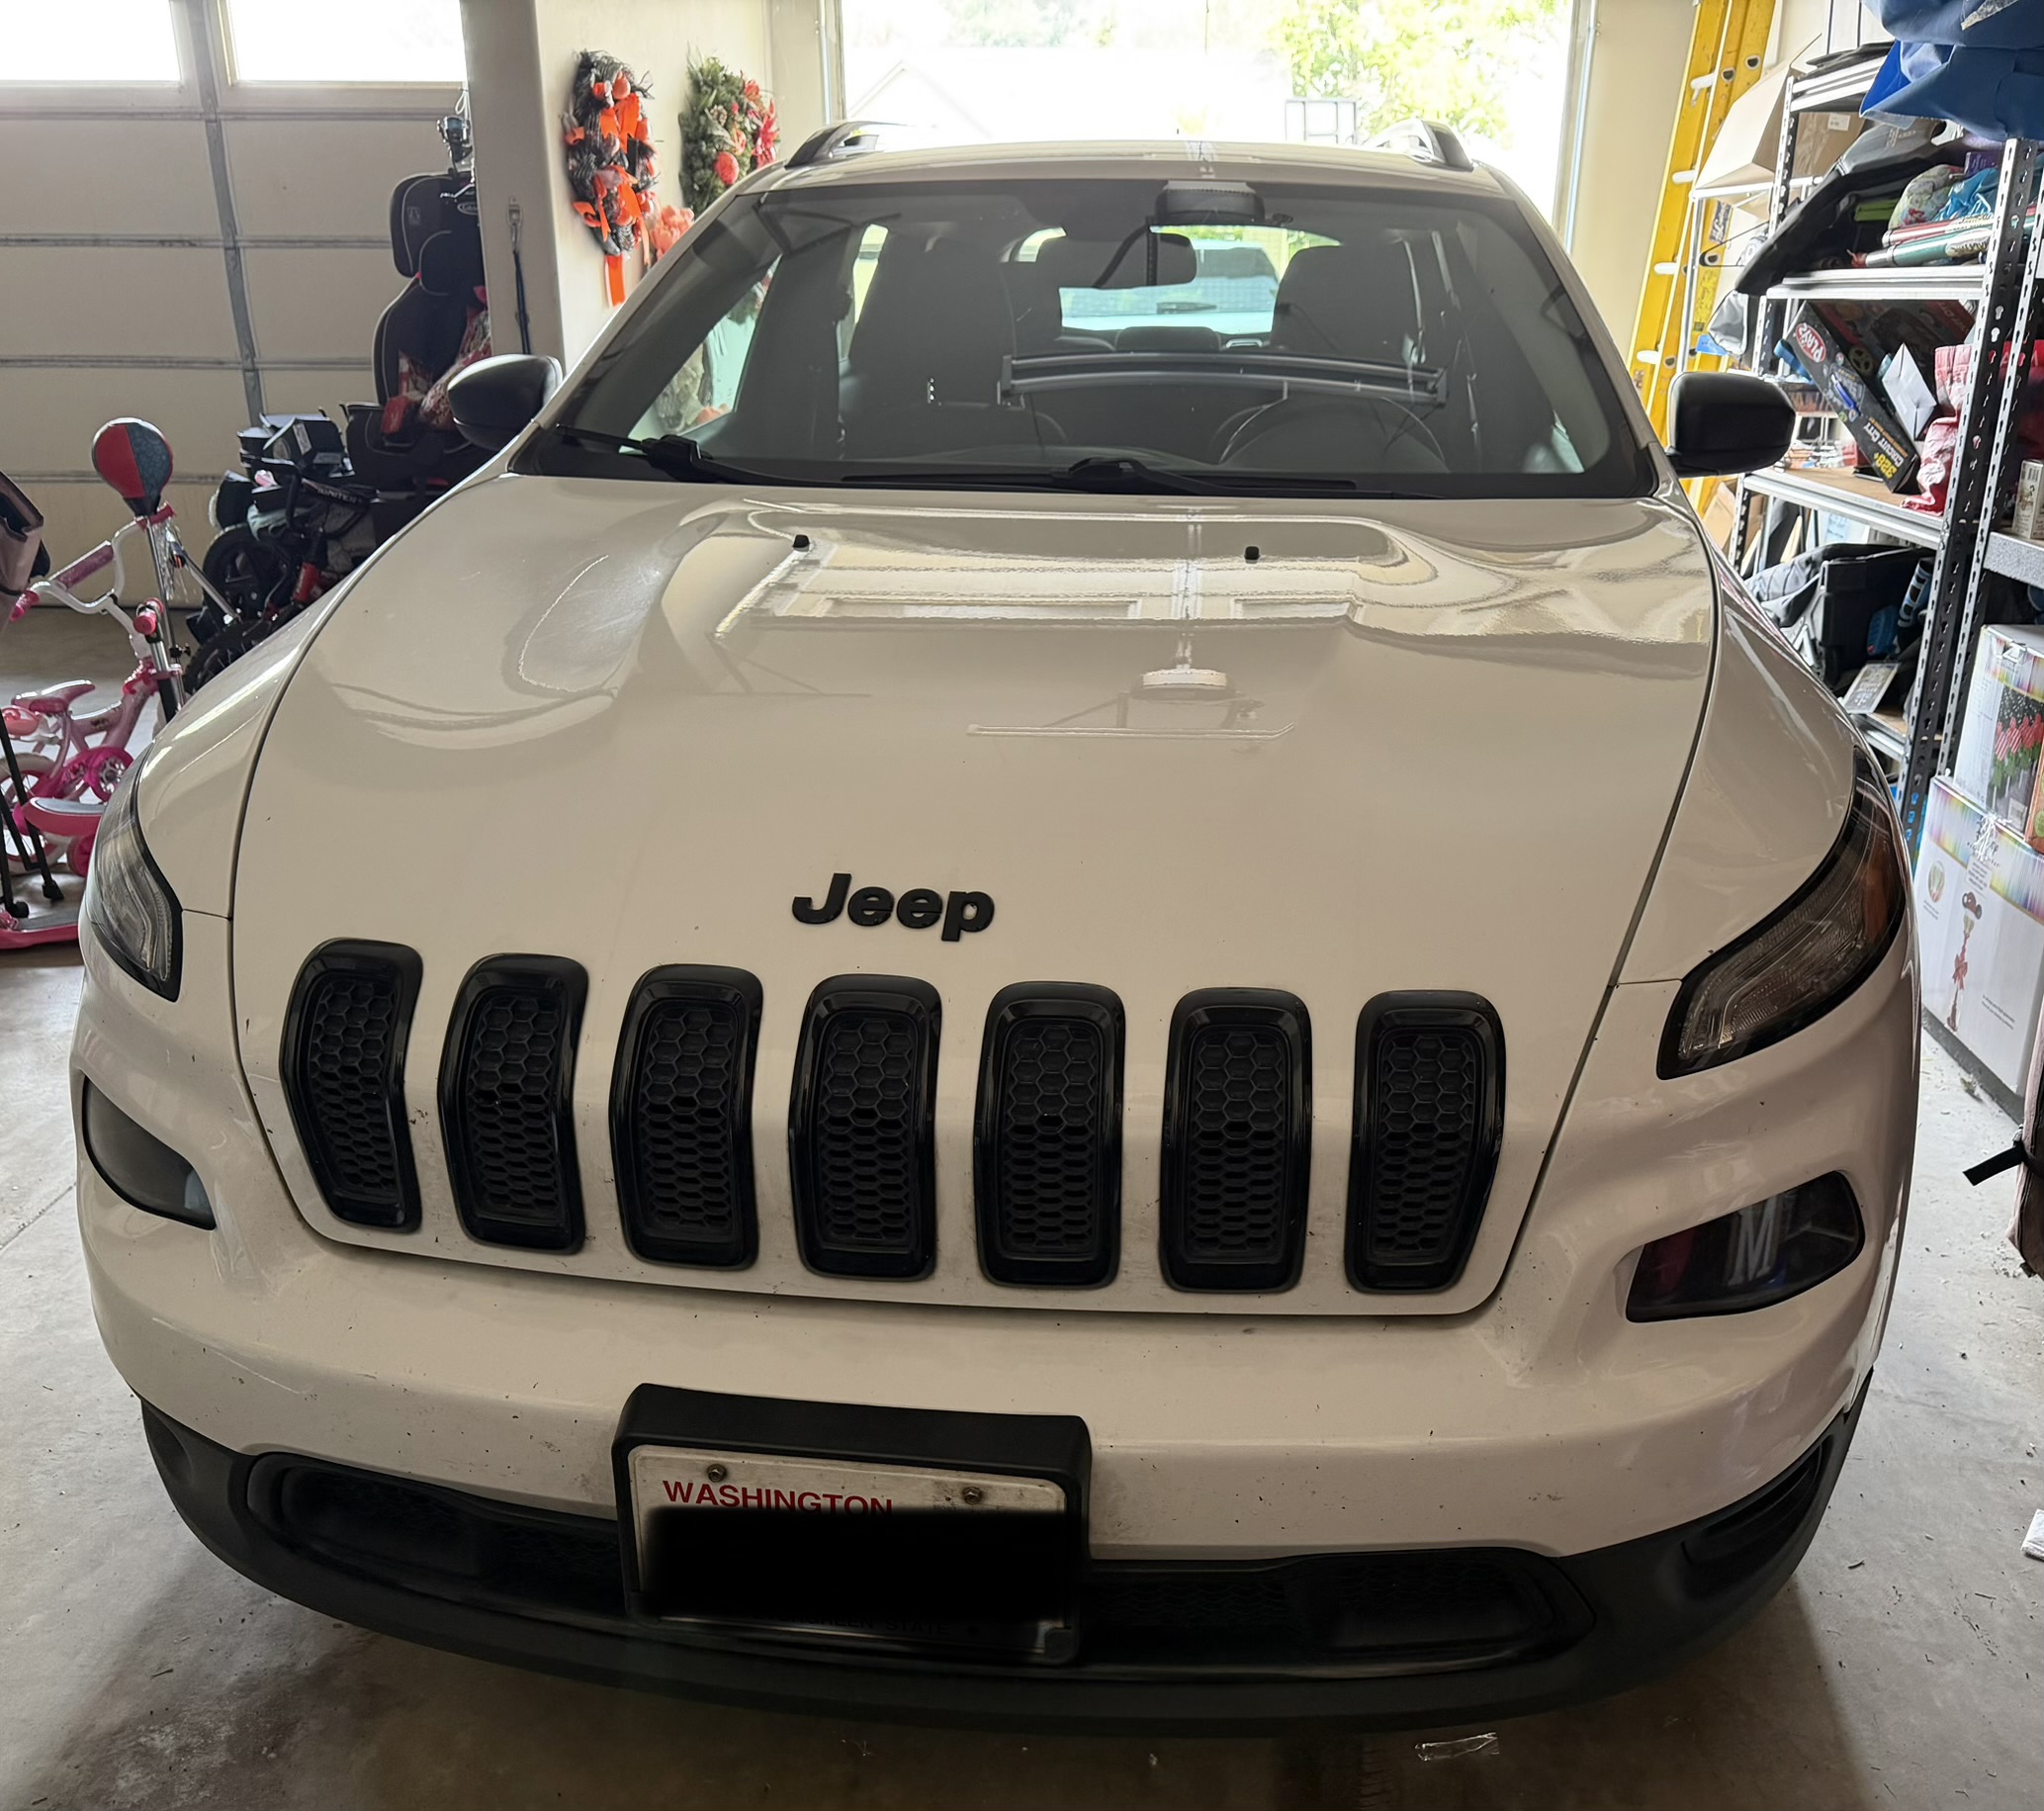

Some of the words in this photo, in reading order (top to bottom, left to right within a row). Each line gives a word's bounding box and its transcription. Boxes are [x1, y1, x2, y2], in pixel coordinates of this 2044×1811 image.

[1863, 421, 1882, 443] CITY
[1878, 437, 1905, 468] CIRCUIT
[792, 872, 995, 942] Jeep
[663, 1480, 893, 1518] WASHINGTON
[885, 1616, 950, 1636] STATE
